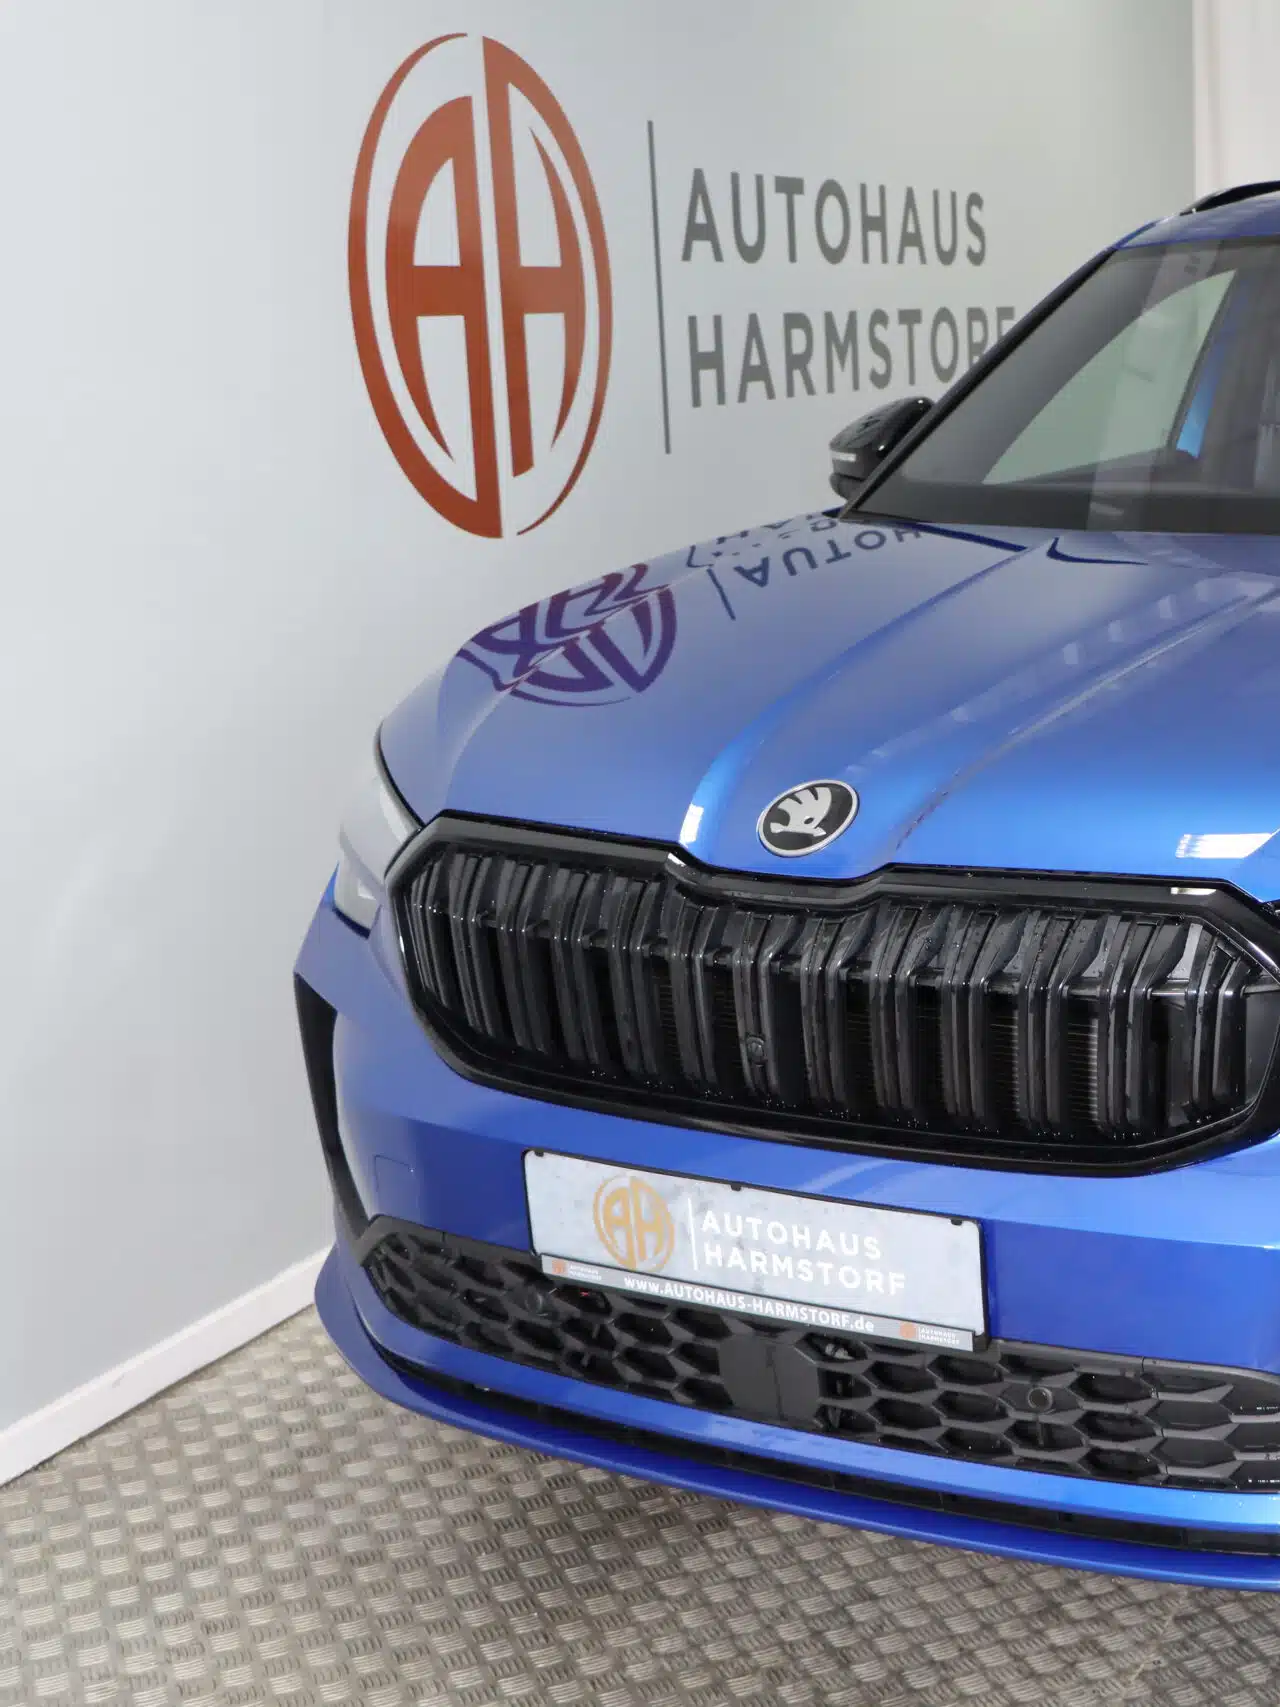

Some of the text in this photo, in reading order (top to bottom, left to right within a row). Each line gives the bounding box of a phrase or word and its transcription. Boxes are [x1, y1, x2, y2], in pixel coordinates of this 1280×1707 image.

[681, 168, 987, 267] AUTOHAUS
[701, 1209, 882, 1260] AUTOHAUS
[703, 1242, 906, 1296] HARMSTORF
[623, 1275, 875, 1333] www.AUTOHAUS-HARMSTORF.de
